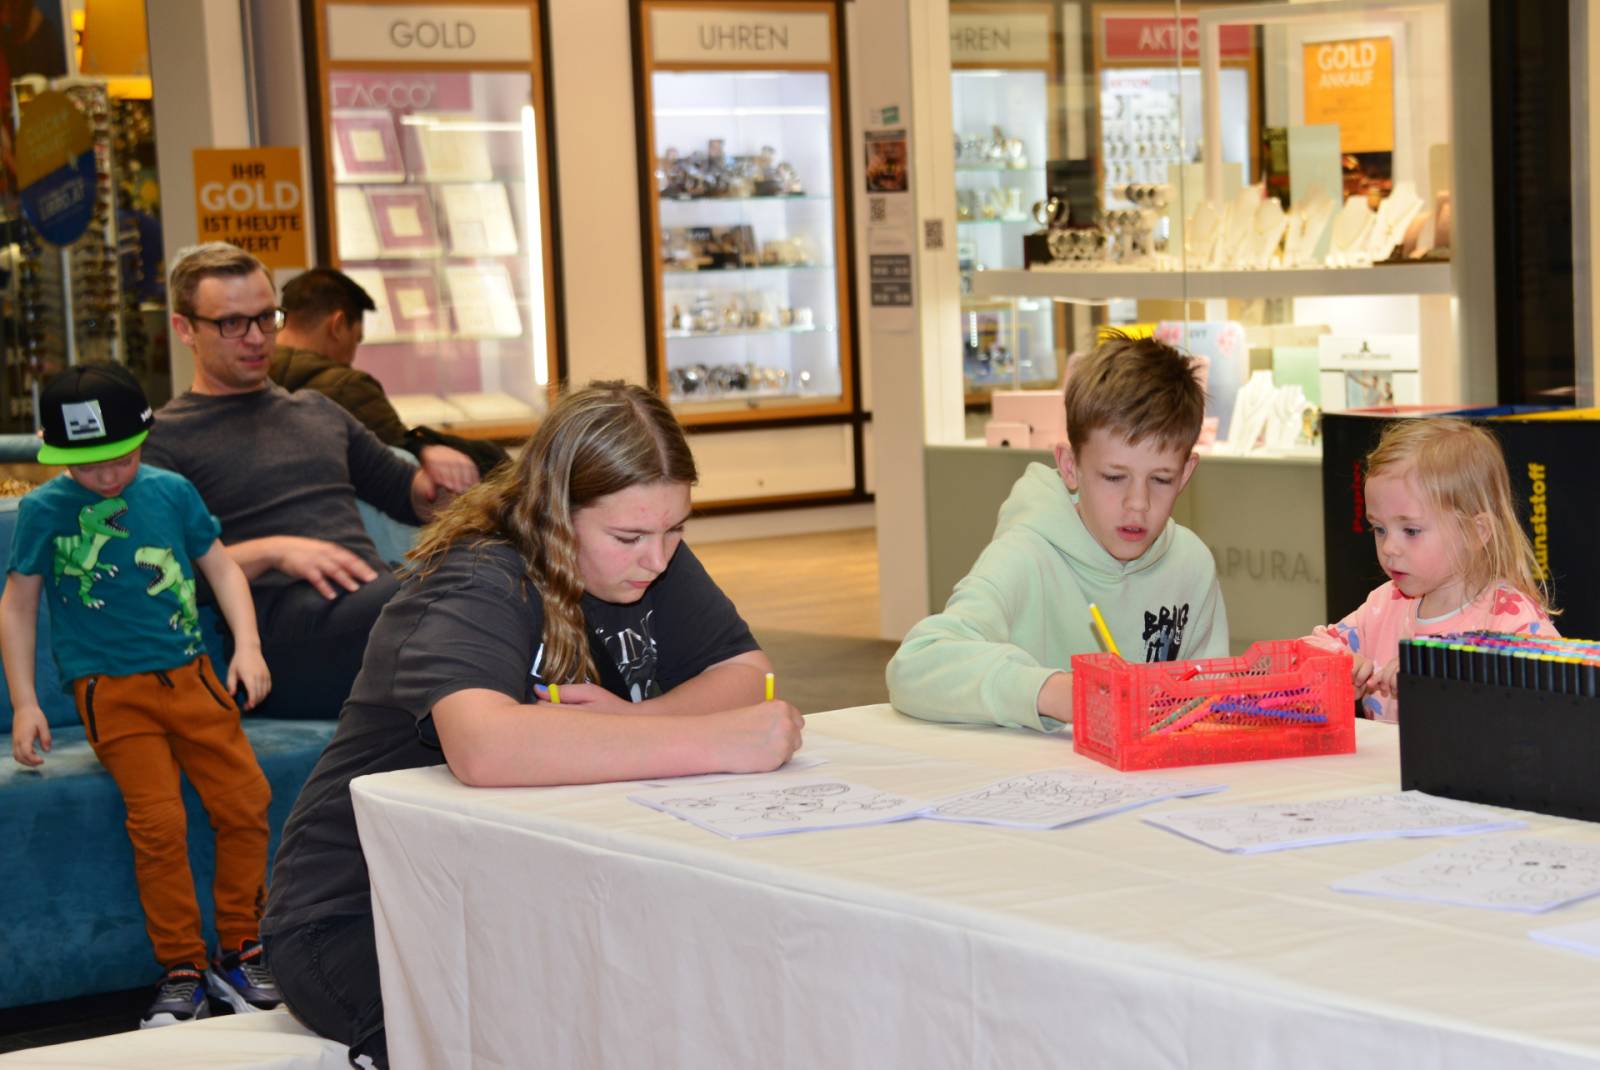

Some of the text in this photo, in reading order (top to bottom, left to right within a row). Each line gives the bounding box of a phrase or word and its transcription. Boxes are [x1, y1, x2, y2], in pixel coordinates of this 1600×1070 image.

[389, 20, 476, 49] GOLD
[698, 24, 789, 51] UHREN
[1317, 43, 1377, 71] GOLD
[231, 163, 266, 179] IHR
[200, 180, 300, 212] GOLD
[203, 214, 301, 233] IST HEUTE
